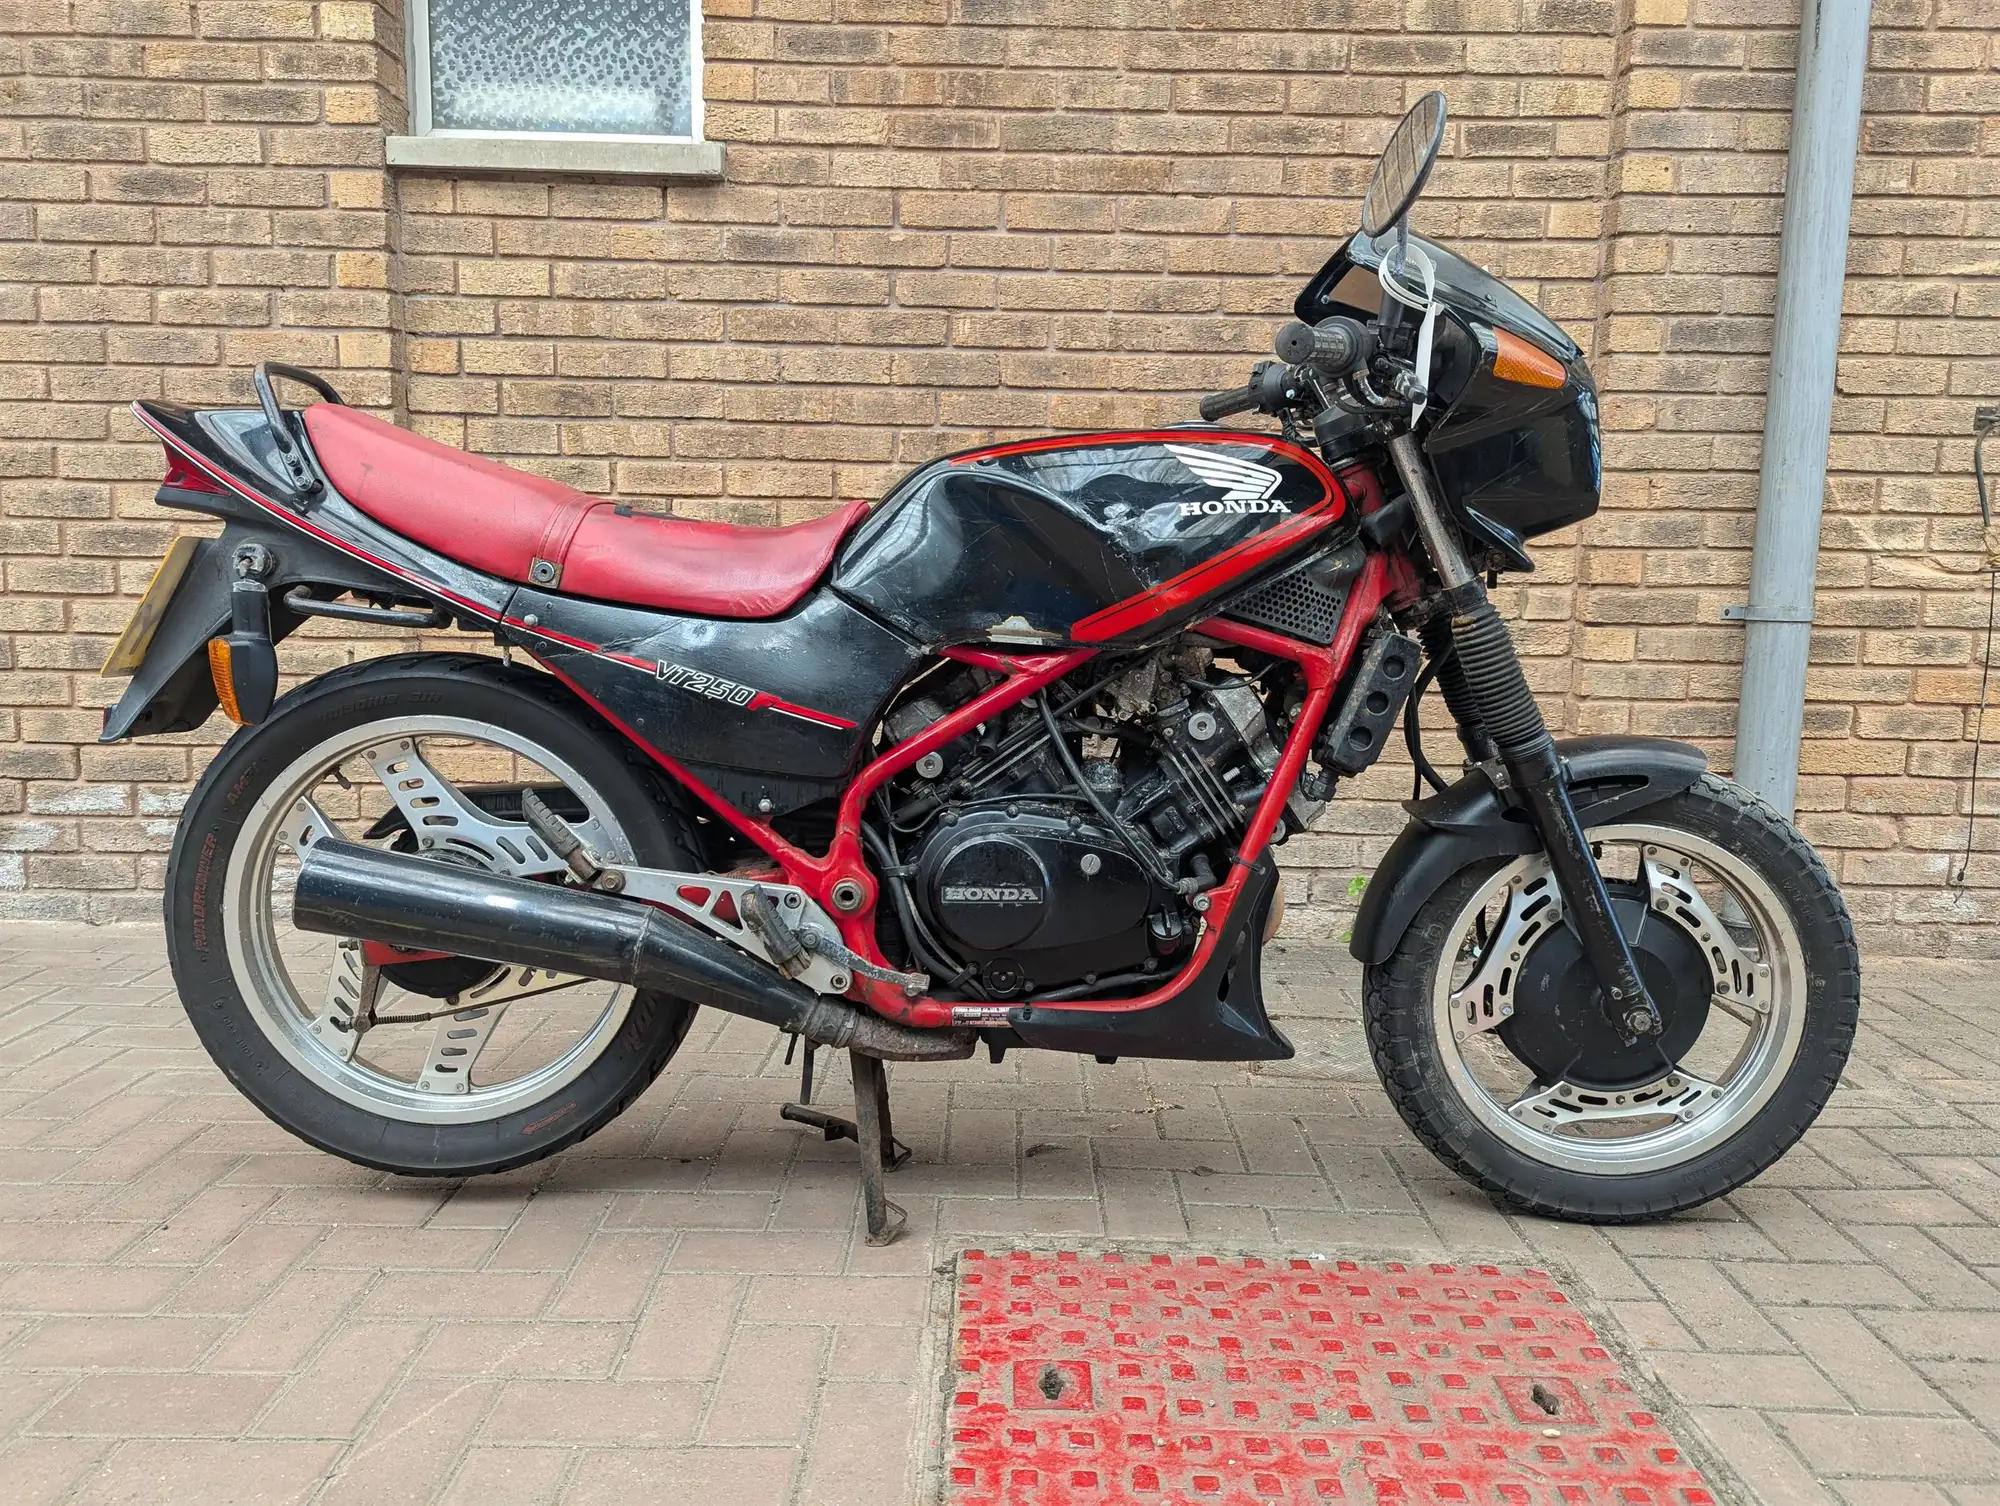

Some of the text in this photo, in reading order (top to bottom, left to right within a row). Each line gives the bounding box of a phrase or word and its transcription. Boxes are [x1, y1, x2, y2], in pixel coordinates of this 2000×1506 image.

[1179, 499, 1291, 517] HONDA
[656, 659, 756, 706] VT250
[192, 834, 218, 952] ROADRUNNER
[945, 887, 1038, 900] HONDA
